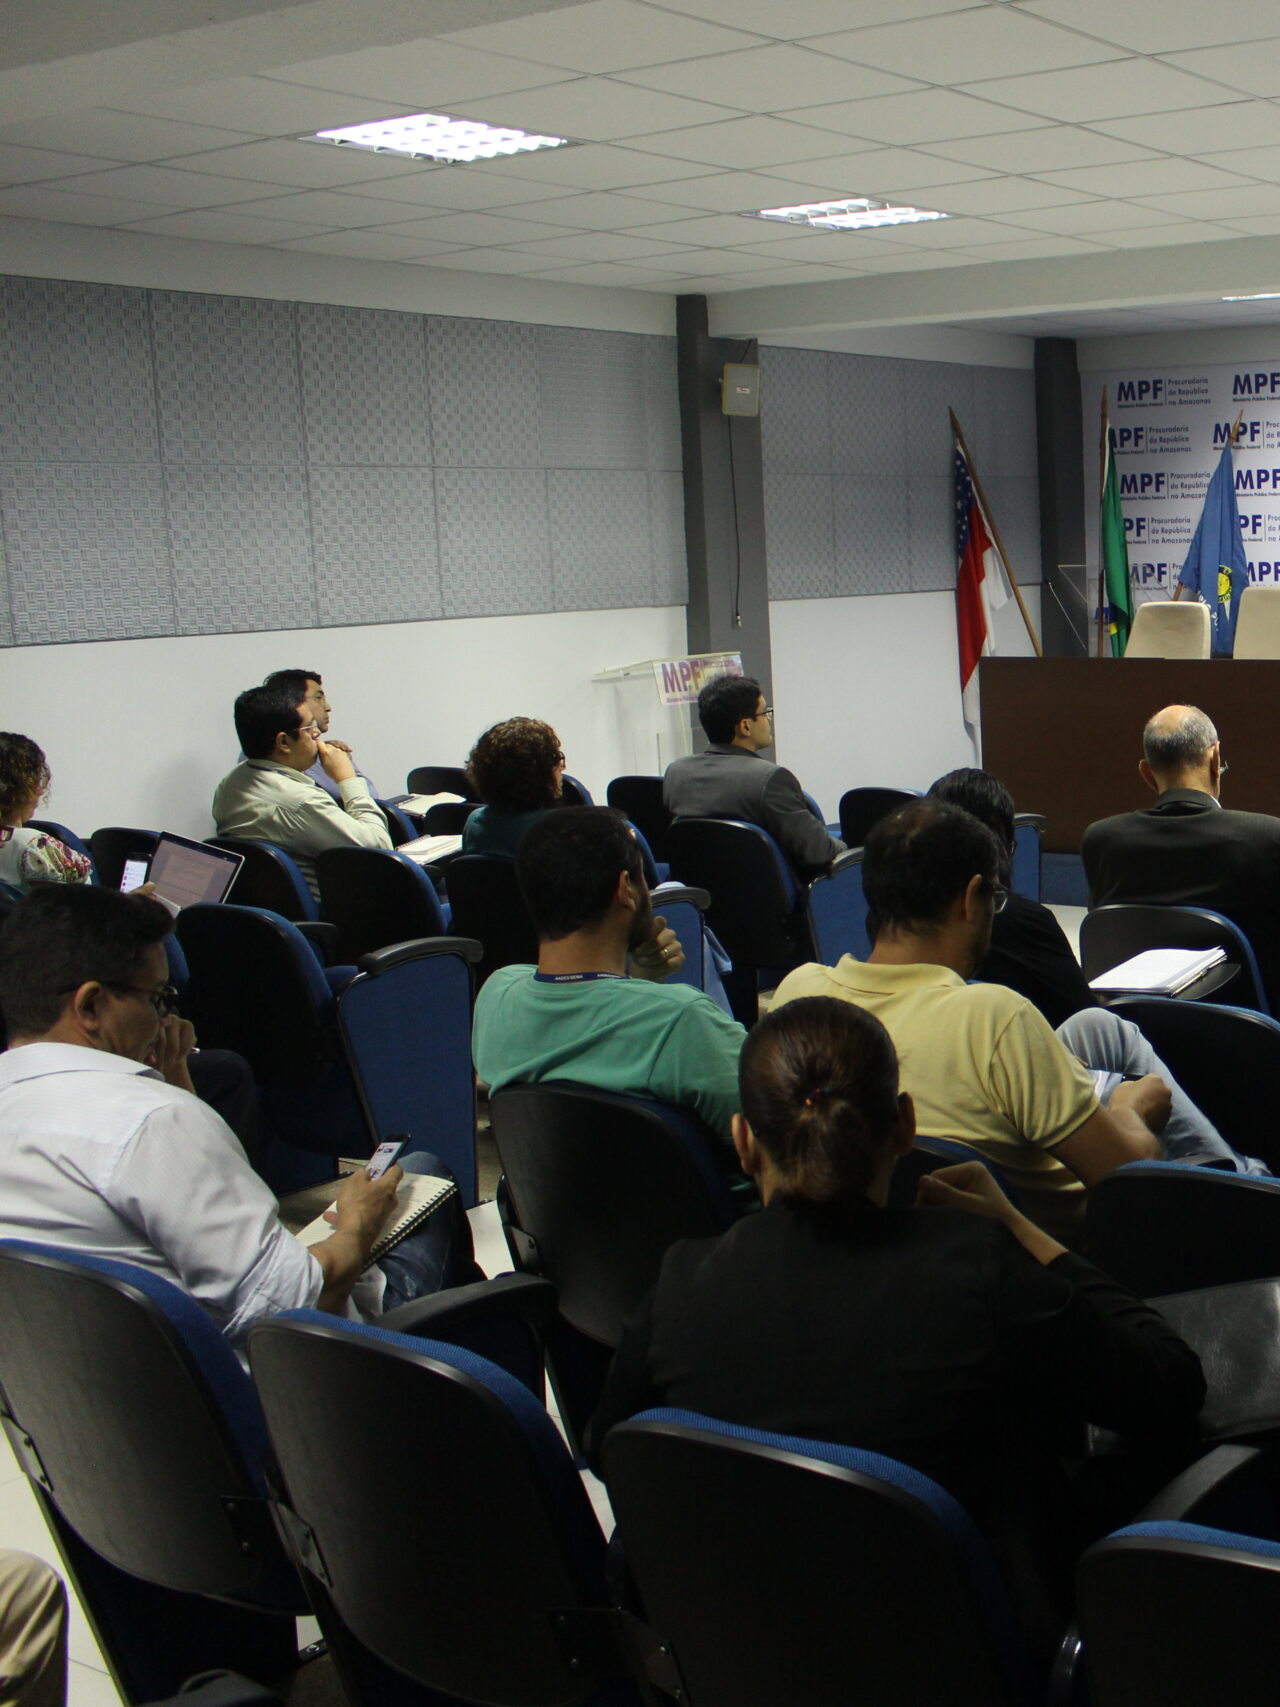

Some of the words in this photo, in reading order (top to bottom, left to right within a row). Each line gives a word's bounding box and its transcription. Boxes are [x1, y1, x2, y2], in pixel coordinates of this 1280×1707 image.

[1117, 379, 1163, 402] MPF
[1232, 372, 1280, 396] MPF
[1120, 472, 1165, 495] MPF
[1180, 492, 1205, 500] Amazon
[661, 660, 700, 693] MPF
